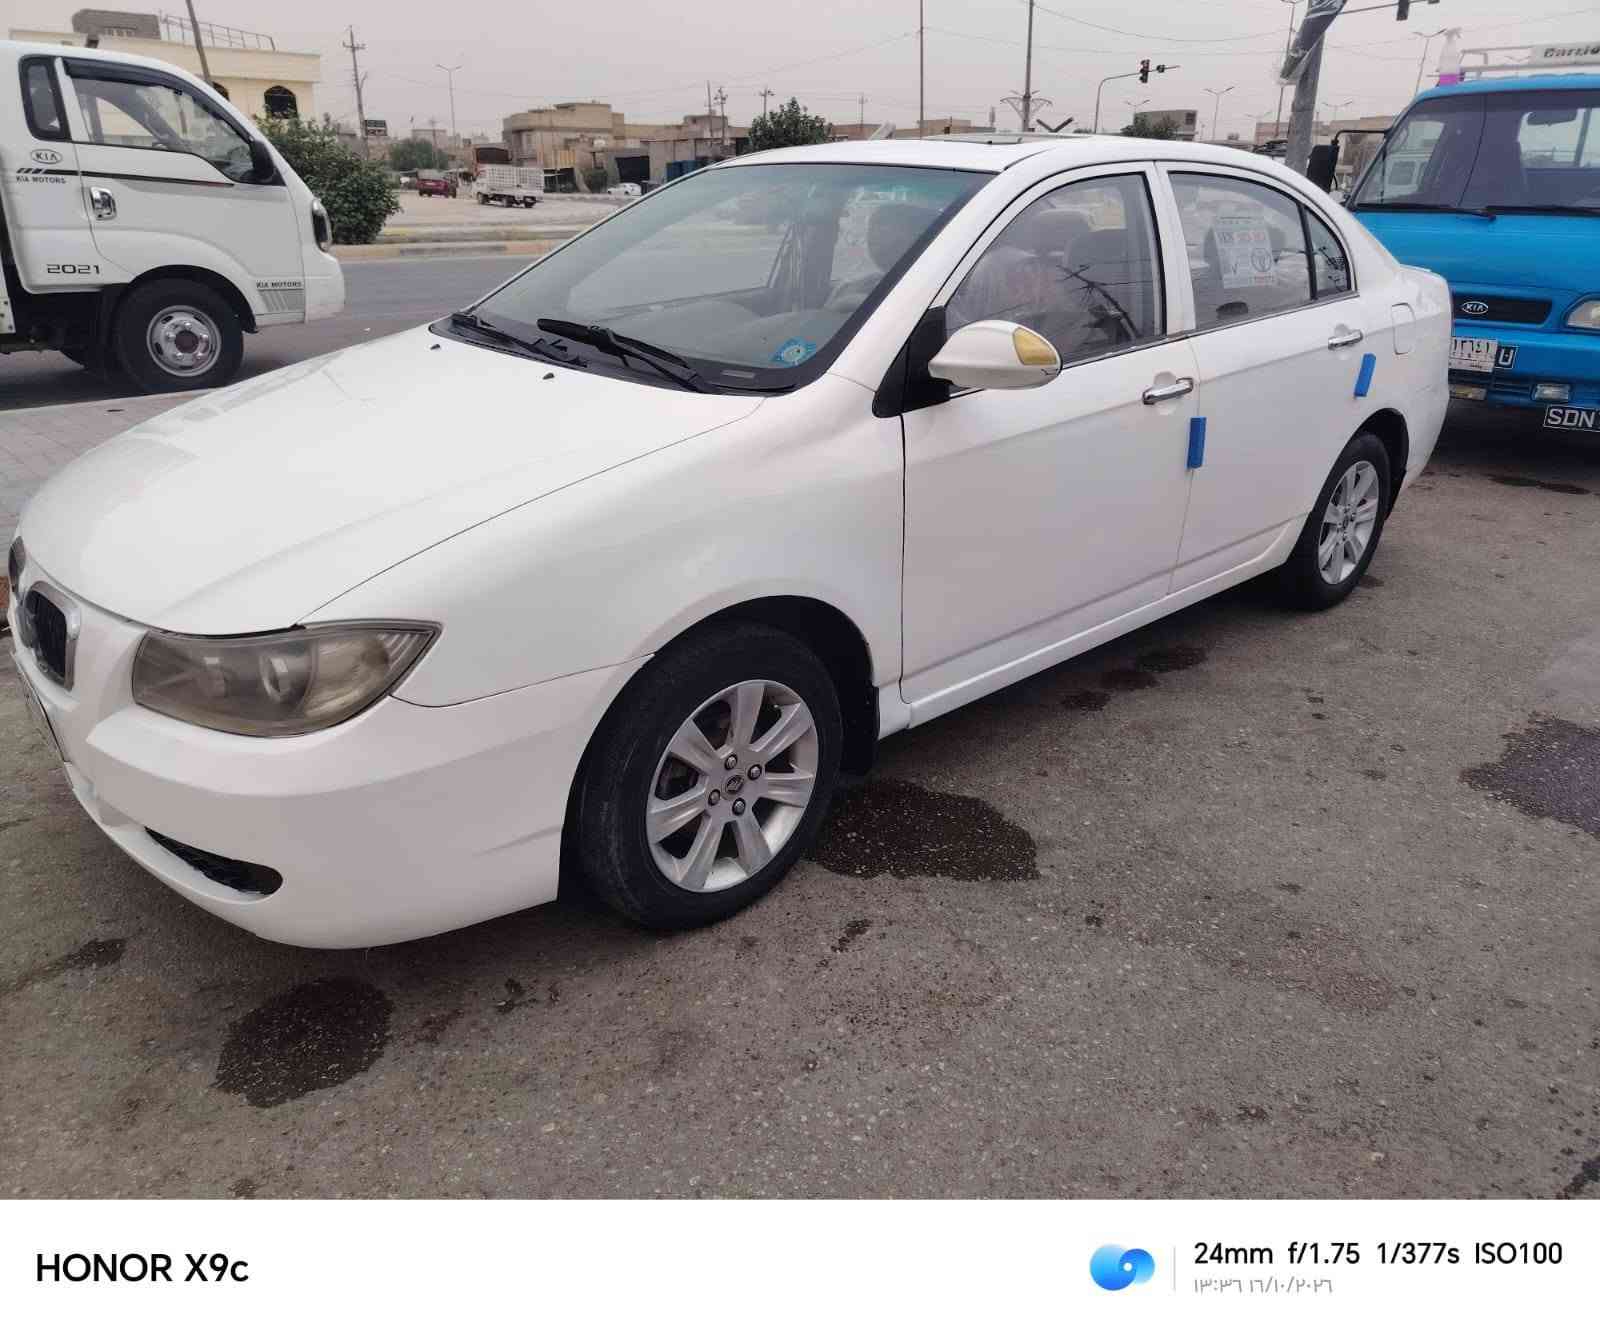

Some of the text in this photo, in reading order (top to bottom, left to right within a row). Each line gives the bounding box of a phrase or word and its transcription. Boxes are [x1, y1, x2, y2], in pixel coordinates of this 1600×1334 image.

[16, 175, 67, 184] KIA MOTORS
[46, 263, 101, 275] 2021
[256, 281, 269, 289] KIA
[1547, 408, 1596, 428] SDN
